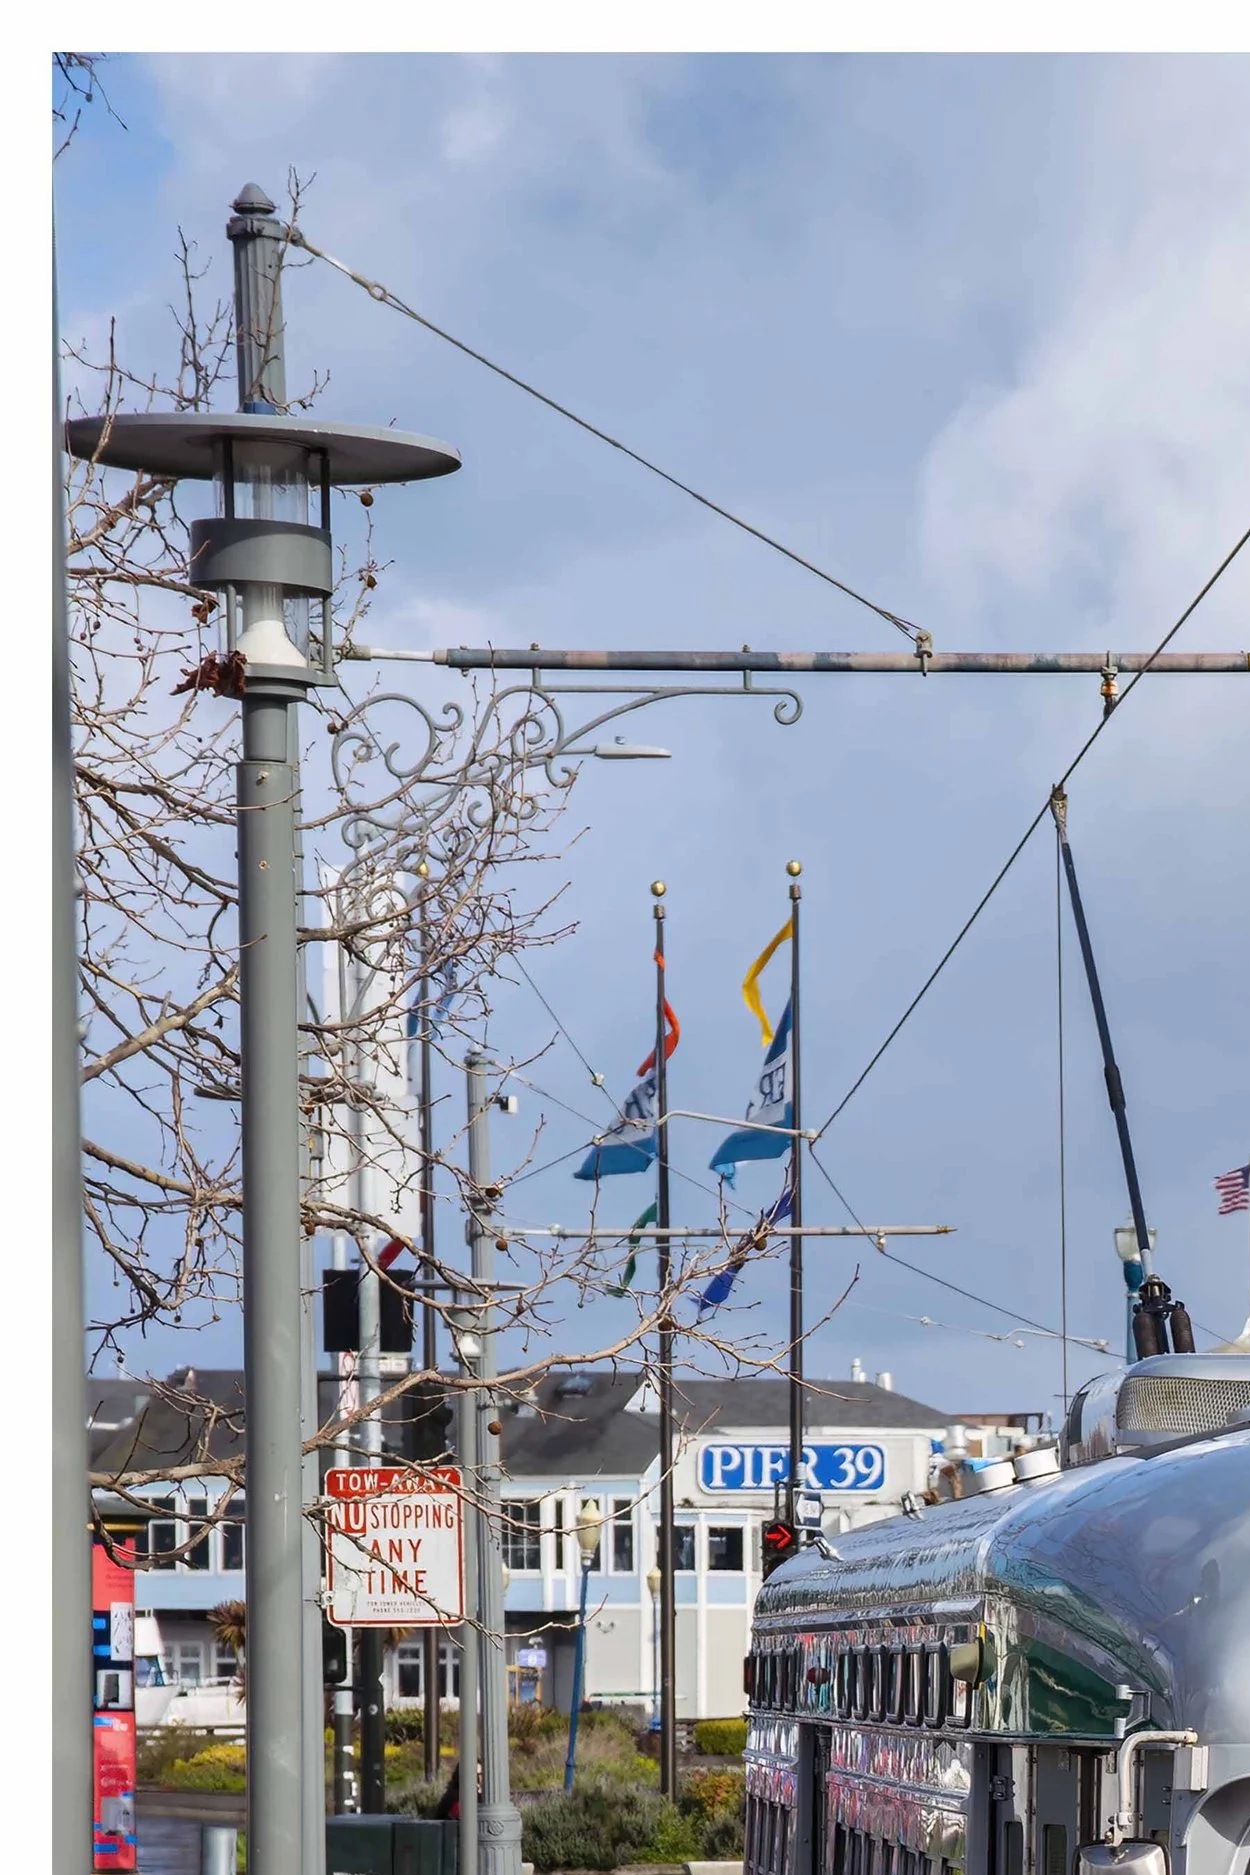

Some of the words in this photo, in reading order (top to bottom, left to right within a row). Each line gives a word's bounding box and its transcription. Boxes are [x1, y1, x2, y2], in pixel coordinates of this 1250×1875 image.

[708, 1446, 824, 1489] PIER
[829, 1447, 882, 1489] 39
[336, 1473, 451, 1491] TOW-AWAY
[331, 1497, 365, 1530] NO
[370, 1503, 454, 1529] STOPPING
[369, 1538, 422, 1563] ANY
[366, 1570, 428, 1594] TIME
